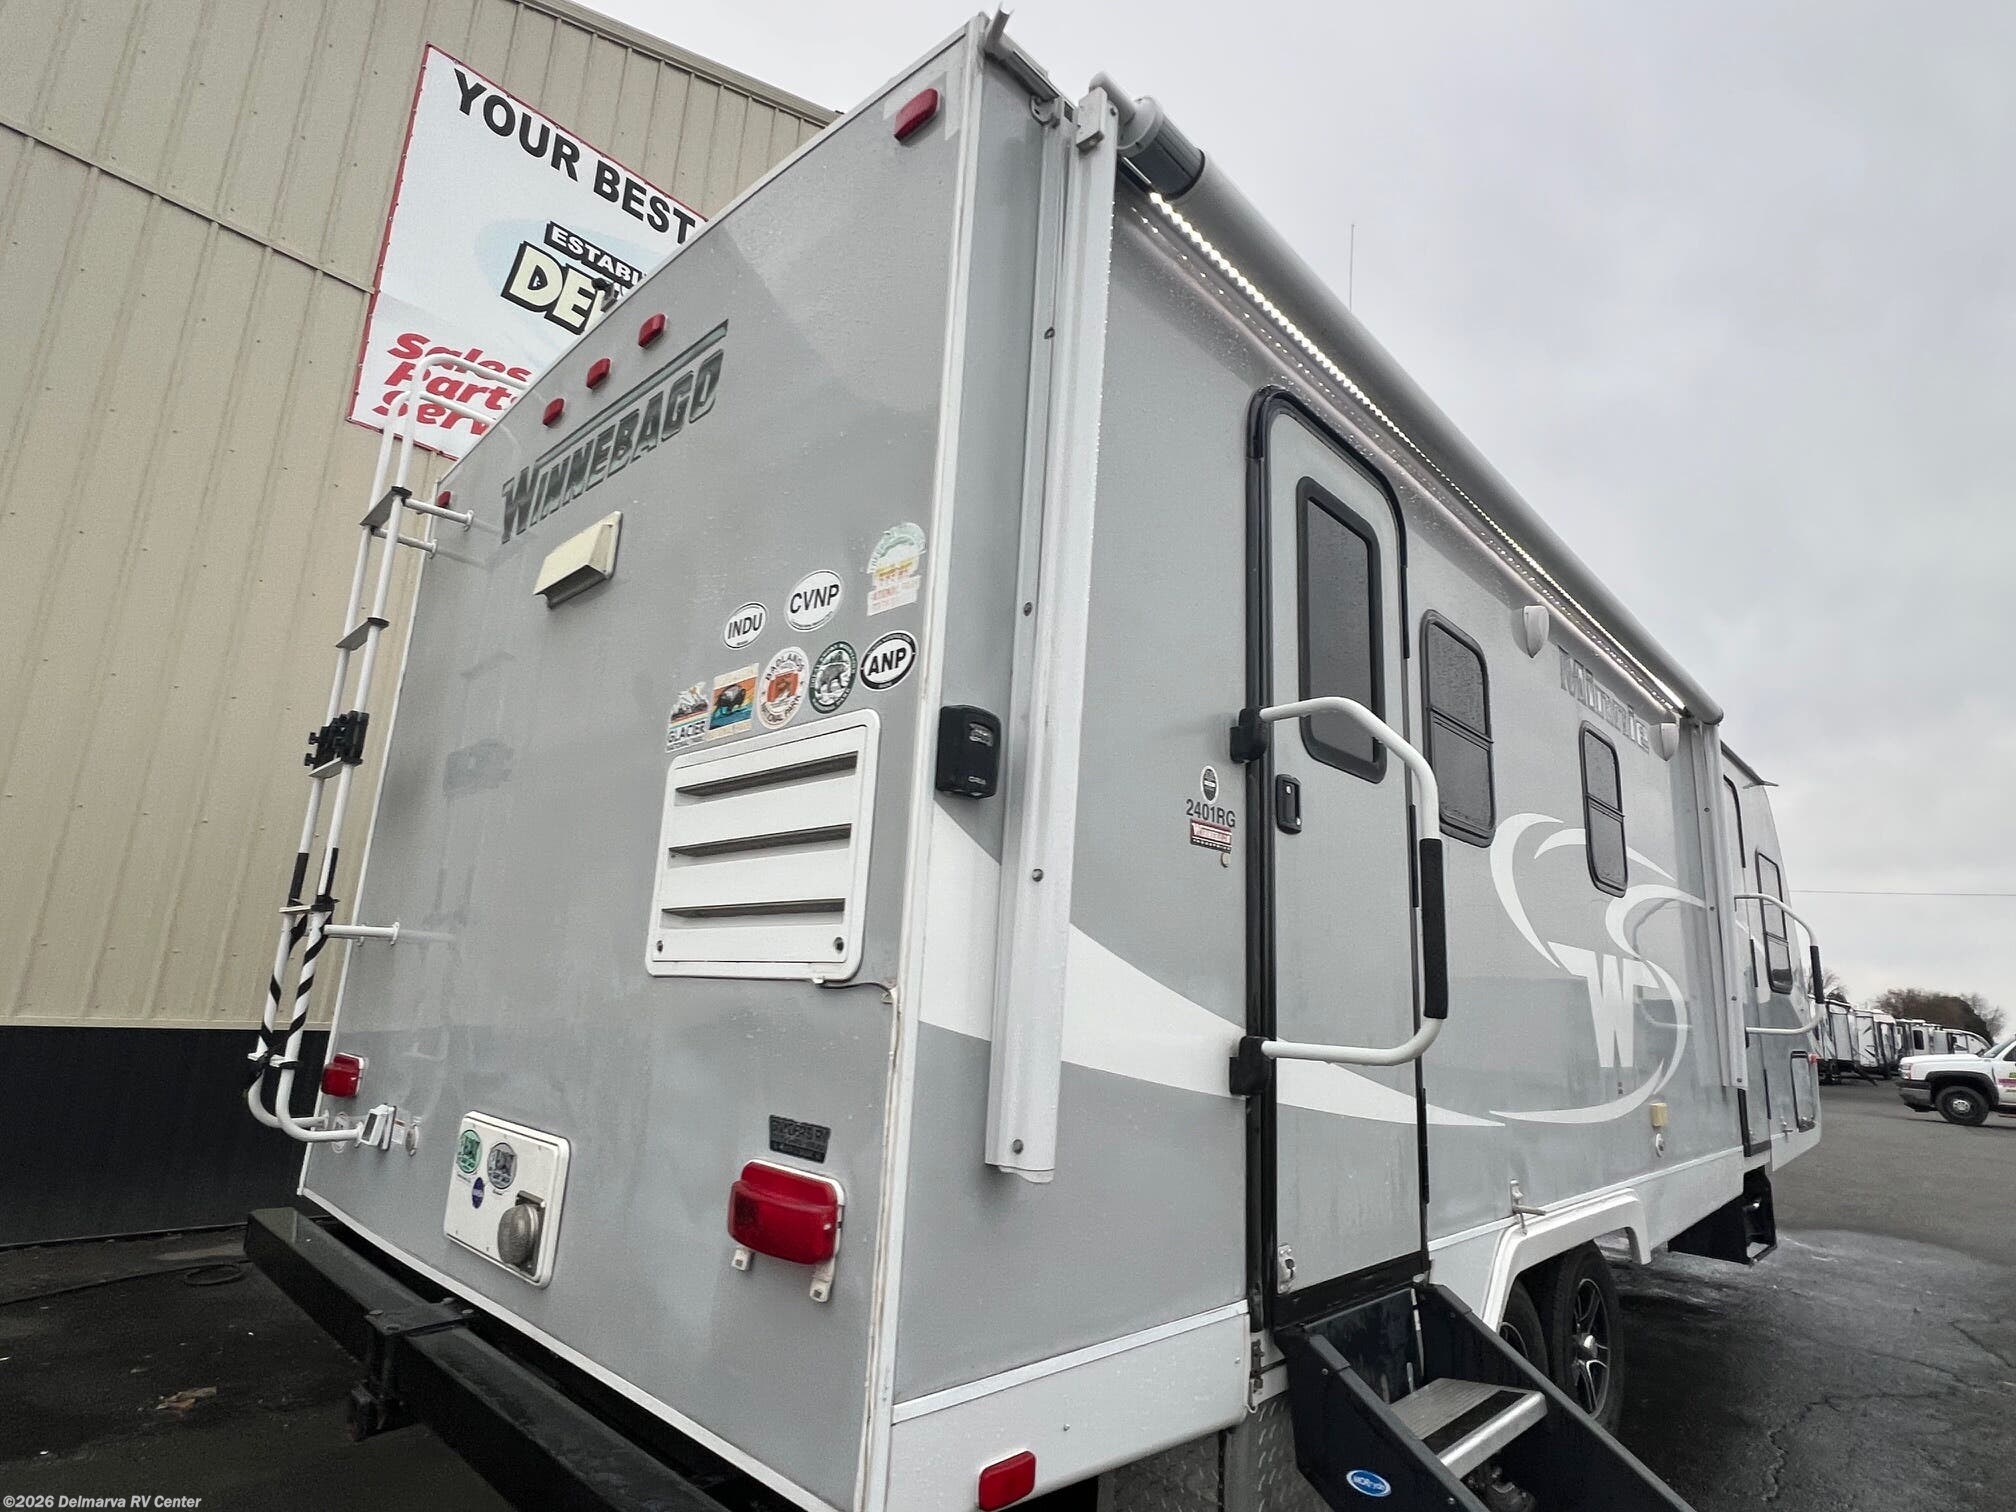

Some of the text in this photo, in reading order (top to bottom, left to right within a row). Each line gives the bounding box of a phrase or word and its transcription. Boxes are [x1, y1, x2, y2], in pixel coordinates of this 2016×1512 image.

[454, 68, 696, 245] YOUR BEST
[501, 349, 725, 545] WINNEBAGO
[789, 583, 840, 614] CVNP
[727, 612, 763, 640] INDU
[867, 646, 907, 677] ANP
[1185, 798, 1236, 828] 2401RG
